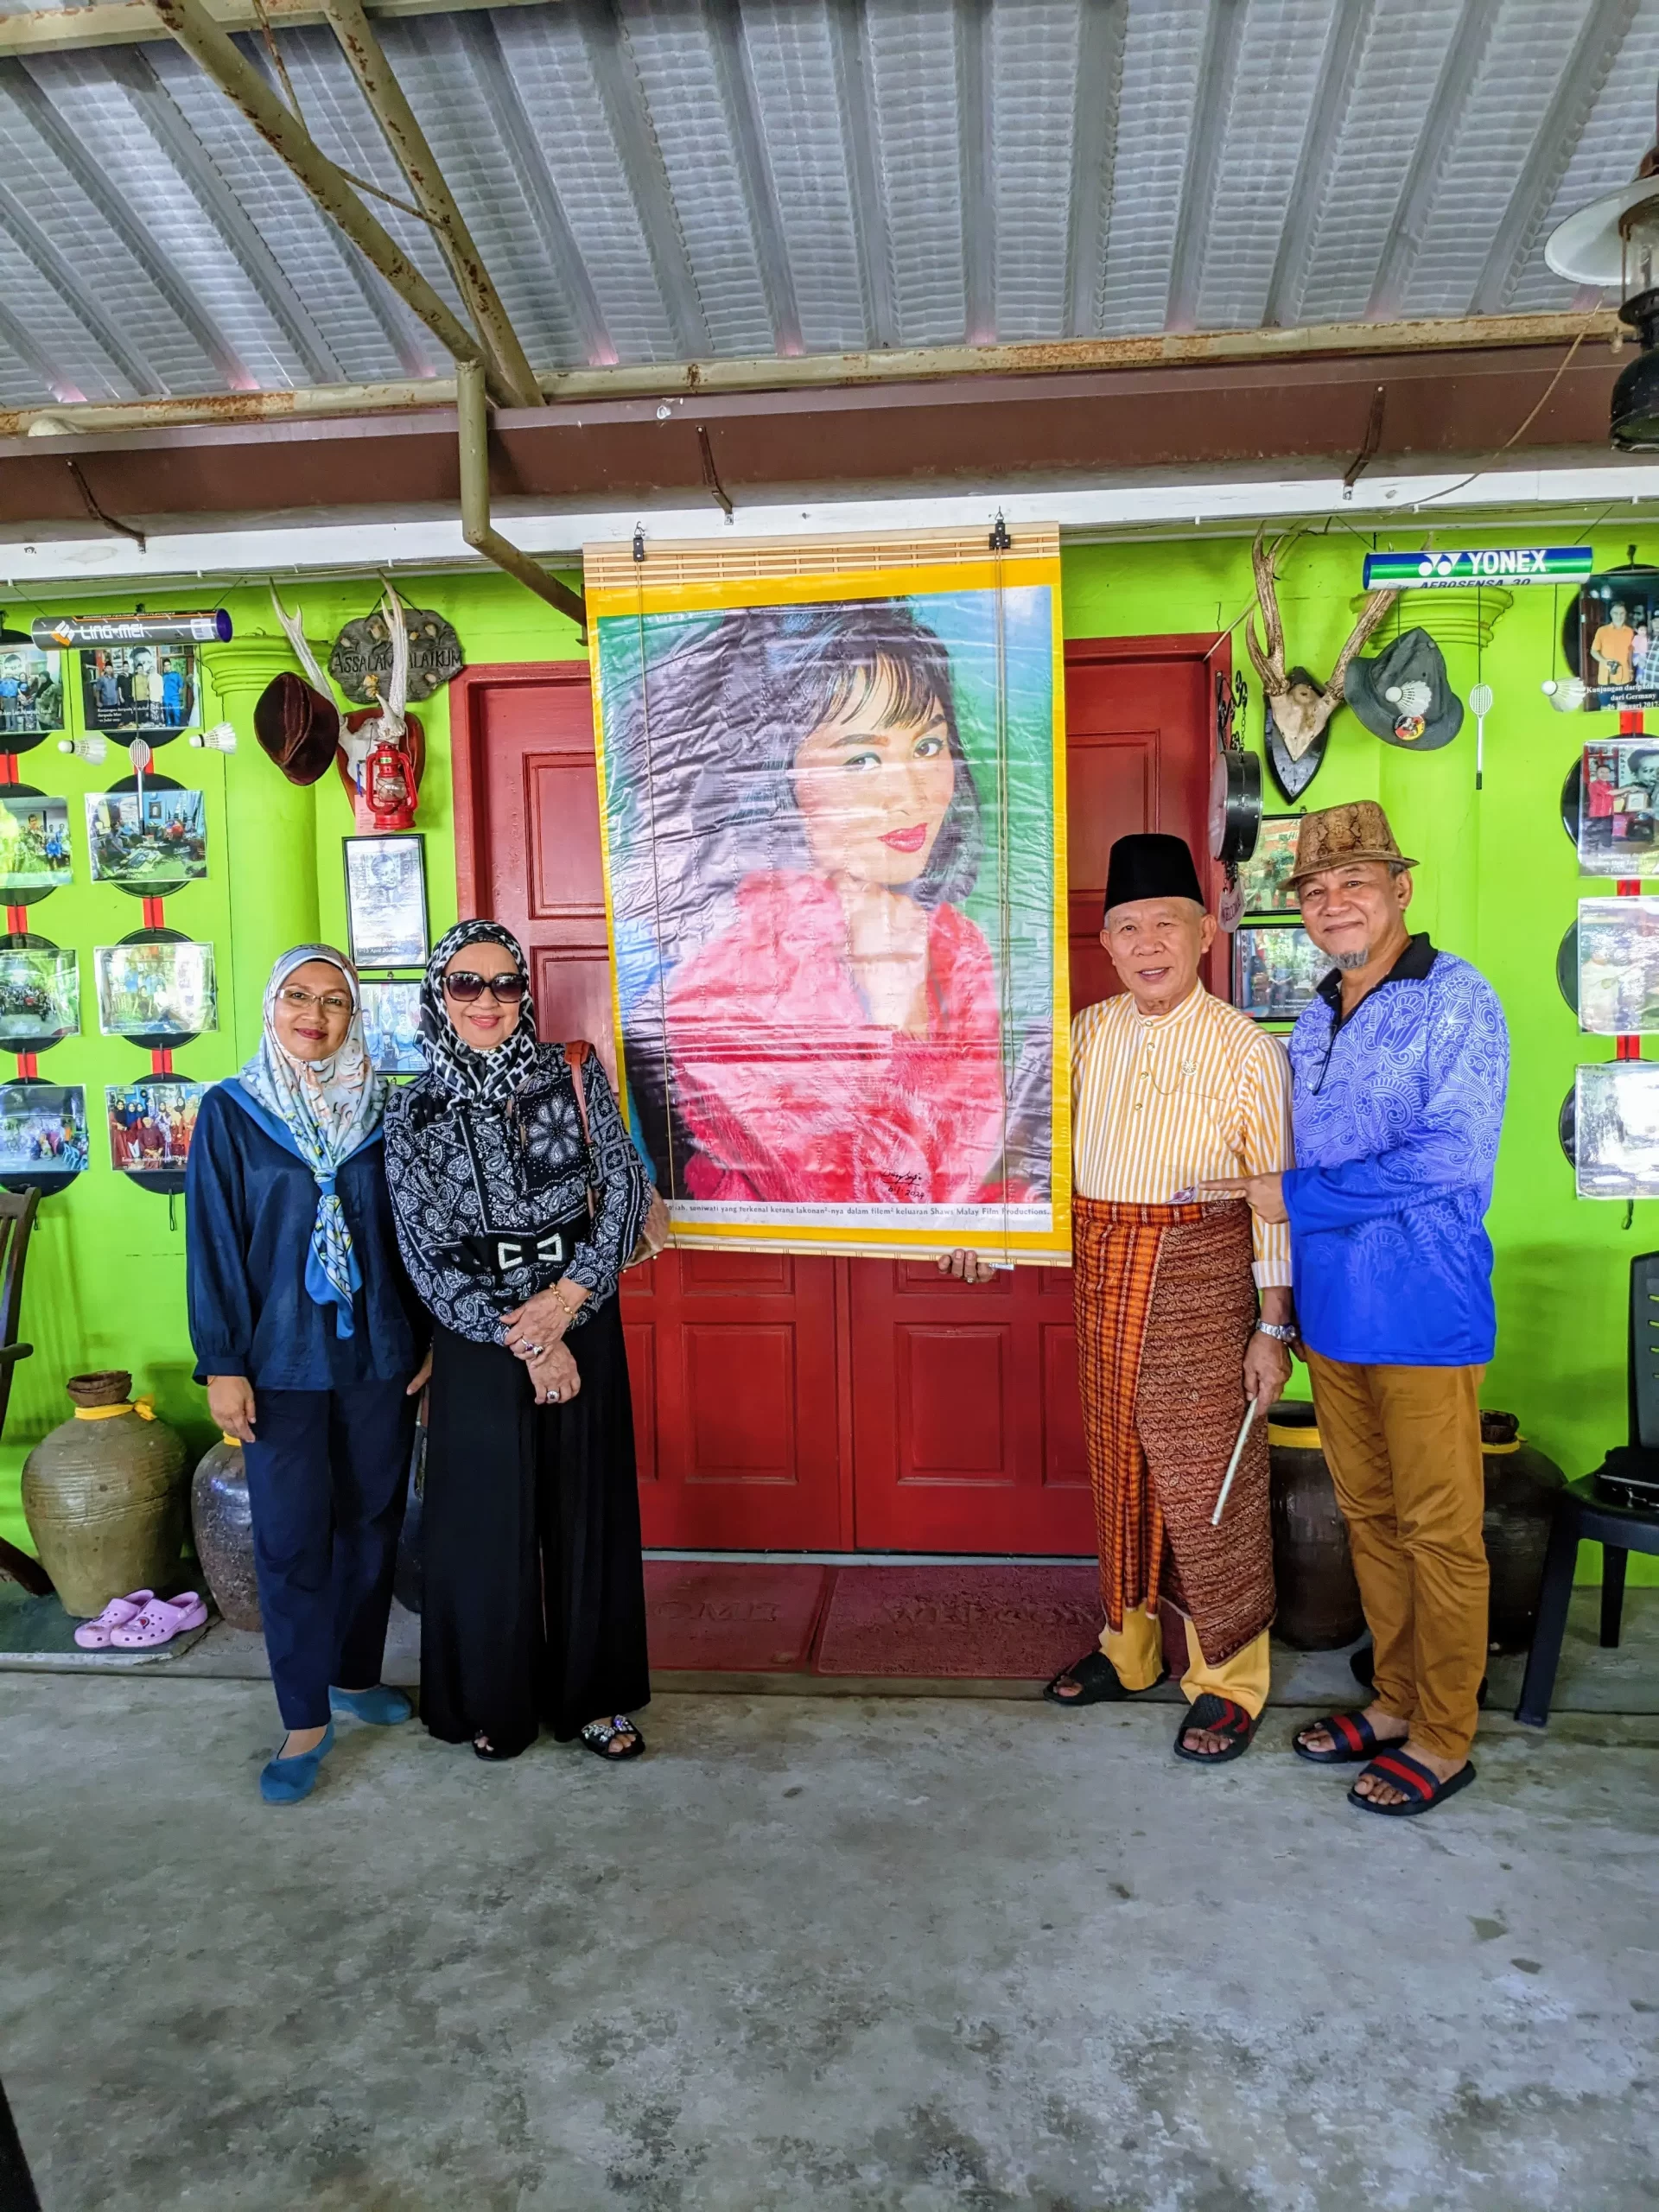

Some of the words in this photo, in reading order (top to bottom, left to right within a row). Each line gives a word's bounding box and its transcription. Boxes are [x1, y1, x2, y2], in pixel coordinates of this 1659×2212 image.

[1466, 550, 1548, 575] YONEX
[1421, 579, 1503, 589] AEROSENSA
[1625, 692, 1656, 701] Germany
[721, 1205, 737, 1214] yang
[847, 1206, 869, 1215] dalam
[957, 1207, 979, 1216] Malay
